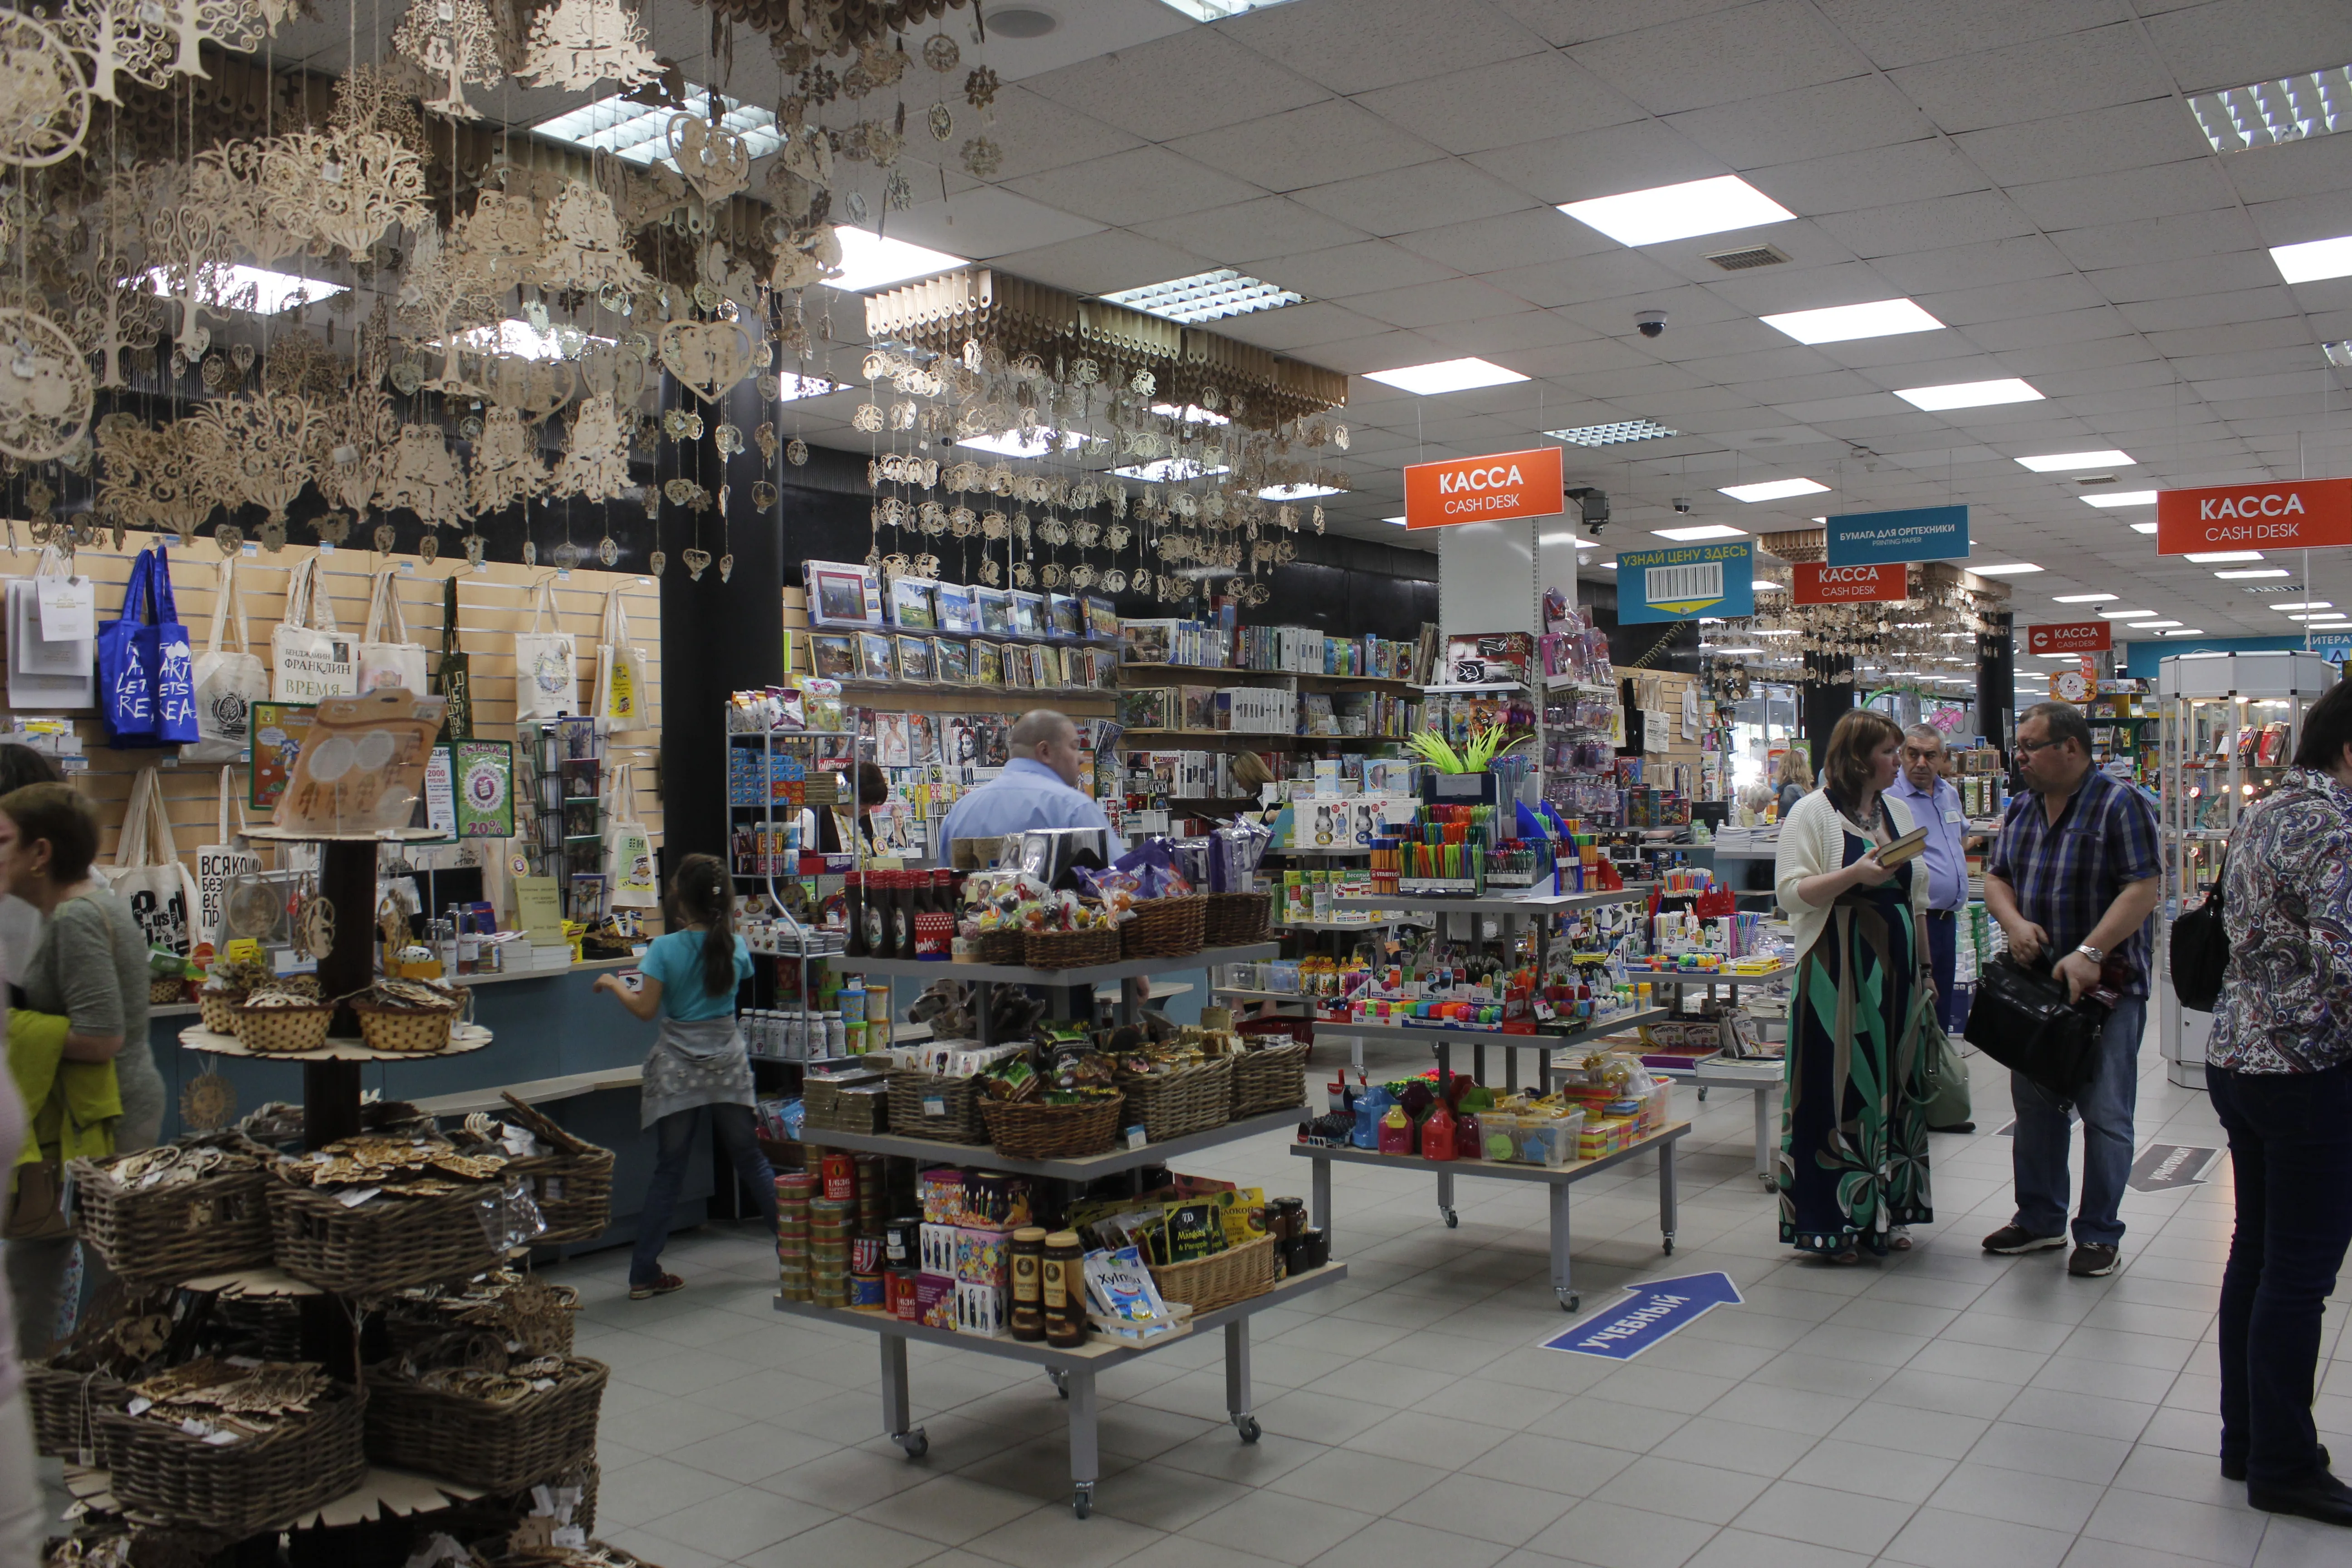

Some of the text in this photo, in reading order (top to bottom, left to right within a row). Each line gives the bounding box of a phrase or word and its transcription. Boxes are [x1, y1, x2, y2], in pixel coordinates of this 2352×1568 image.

[1440, 465, 1524, 494] КАССА
[1445, 493, 1520, 515] CASH DESK
[2201, 494, 2305, 520] КАССА
[1840, 524, 1955, 541] БУМАГА ДЛЯ ОРГТЕХНИКИ
[2205, 523, 2299, 541] CASH DESK
[1622, 545, 1748, 568] УЗНАЙ ЦЕНУ ЗДЕСЬ
[1819, 565, 1879, 583] КАССА
[1822, 586, 1876, 596] CASH DESK
[2055, 627, 2098, 639] КАССА
[2303, 635, 2352, 645] ЛИТЕРА
[285, 649, 330, 660] БЕНДЖАМИН
[284, 658, 351, 675] ФРАНКЛИН
[458, 743, 509, 760] СКИДКА
[1149, 784, 1168, 794] ЧАСЫ
[467, 820, 503, 835] 20%
[1181, 1212, 1194, 1223] 7D
[1577, 1294, 1691, 1349] УЧЕБНЫЙ
